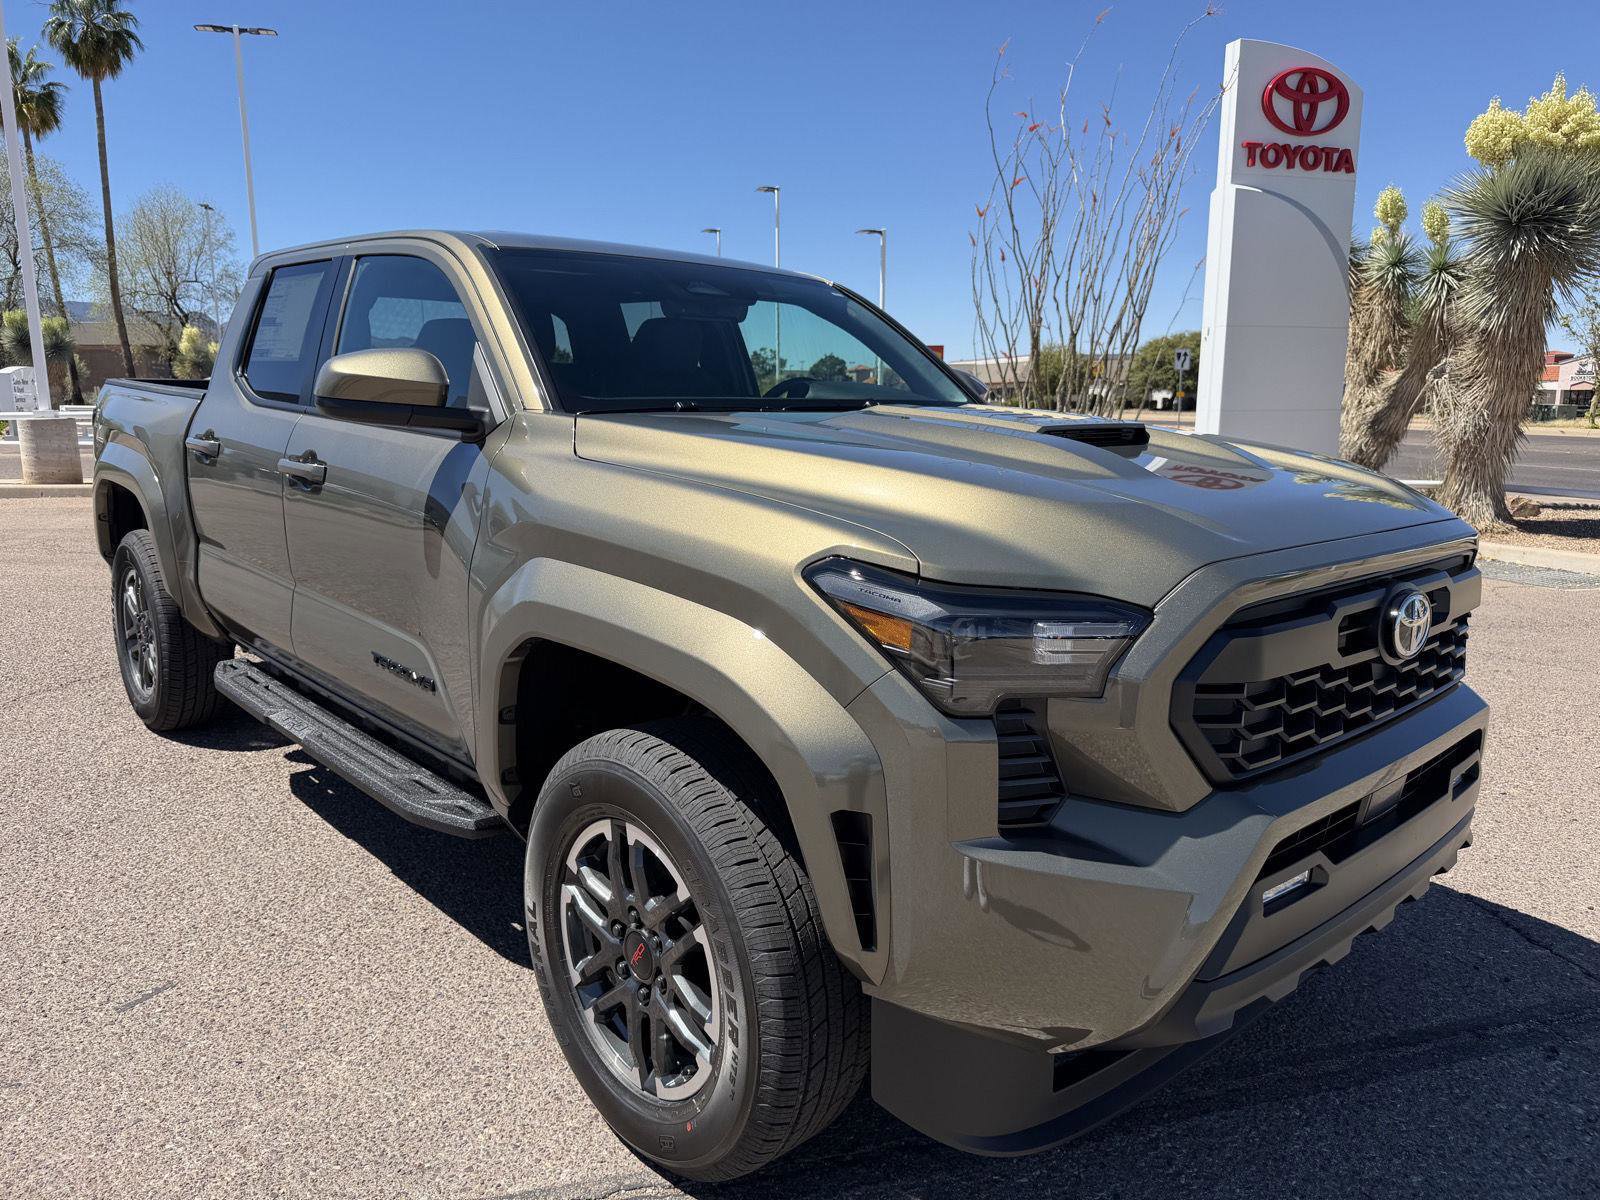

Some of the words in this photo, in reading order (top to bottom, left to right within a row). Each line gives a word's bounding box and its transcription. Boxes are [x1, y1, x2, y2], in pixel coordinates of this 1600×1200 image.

[1242, 140, 1355, 174] TOYOTA
[859, 587, 902, 603] TACOMA
[630, 942, 646, 967] TRD
